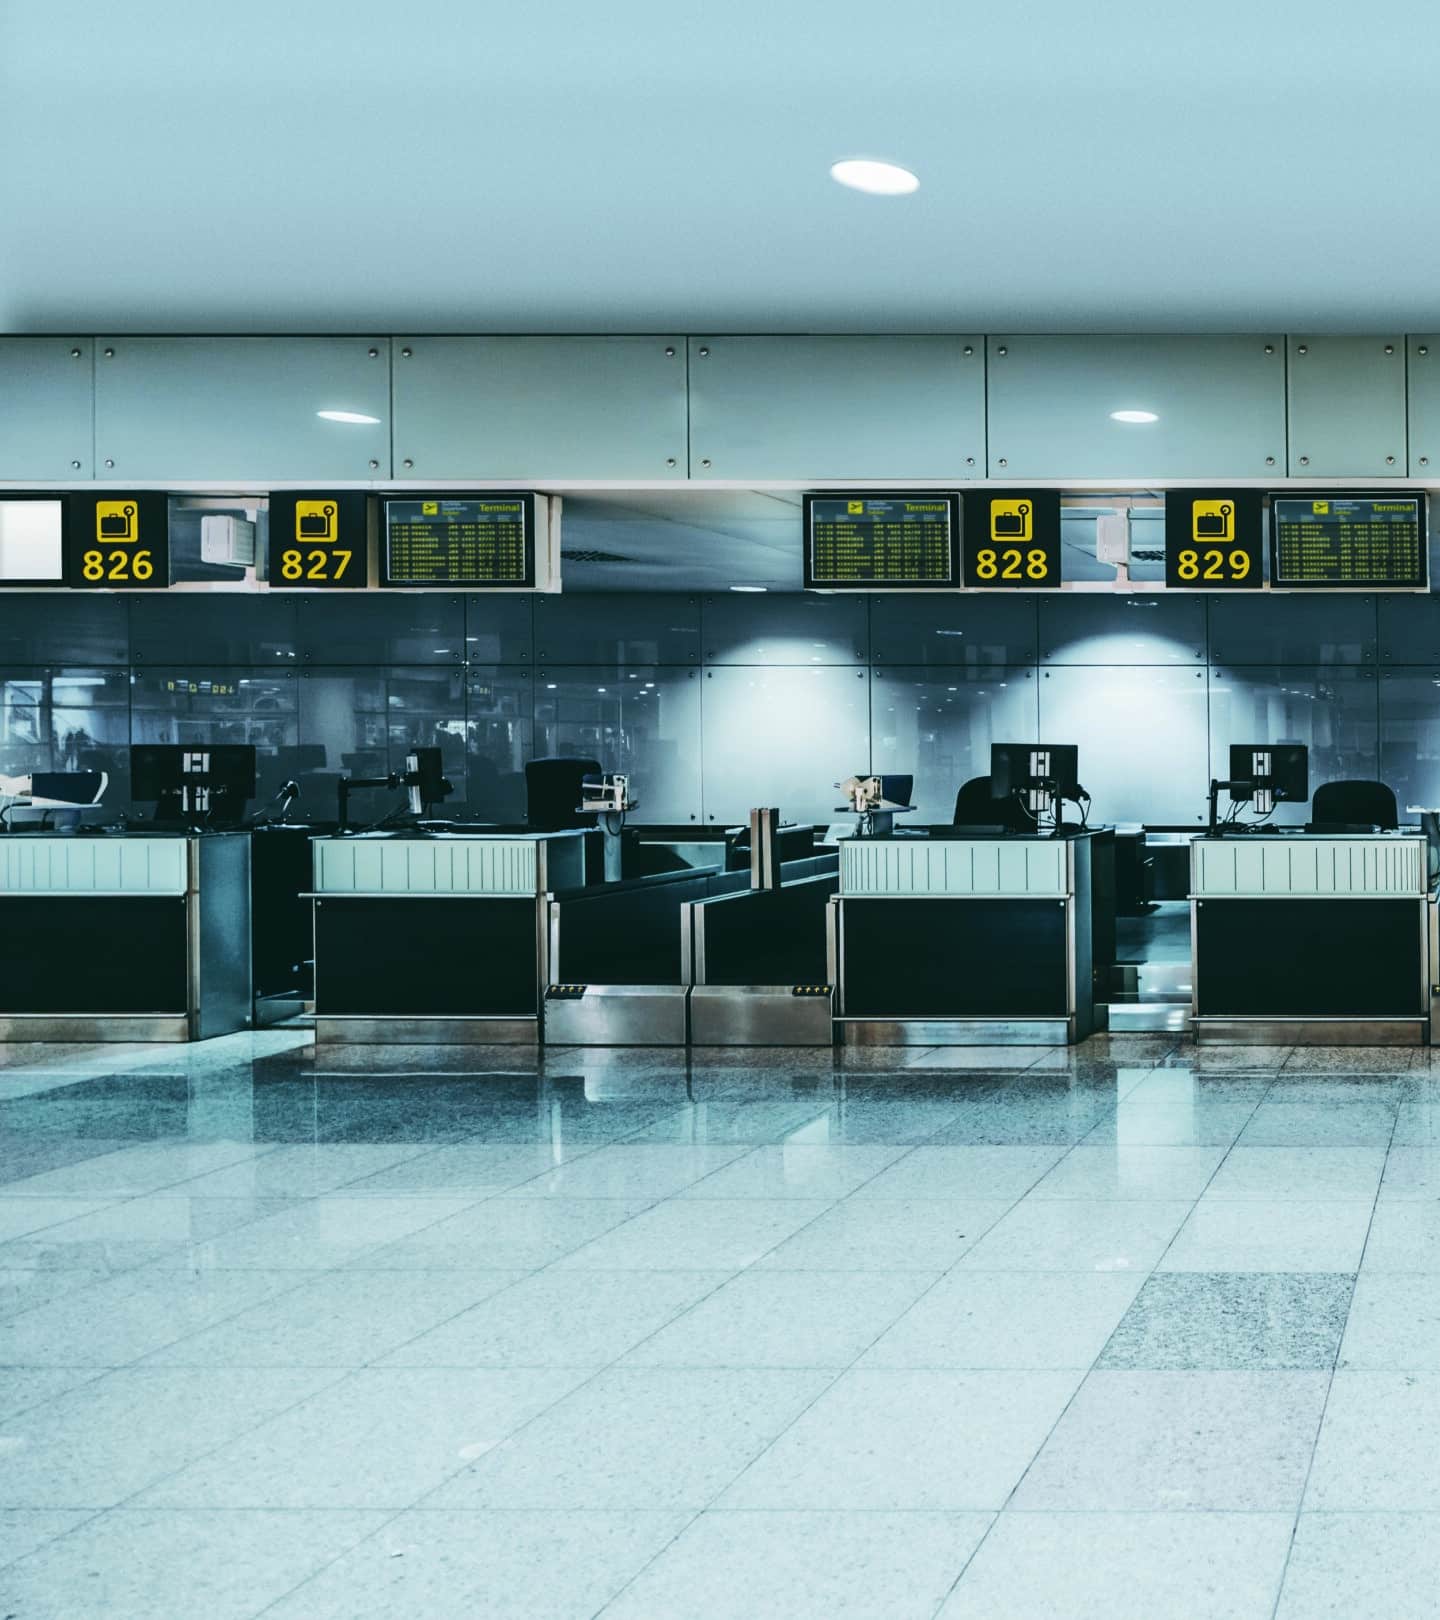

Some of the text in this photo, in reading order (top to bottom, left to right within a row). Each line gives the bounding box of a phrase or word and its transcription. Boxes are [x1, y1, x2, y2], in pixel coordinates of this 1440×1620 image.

[480, 504, 520, 512] Terminal
[905, 503, 945, 511] Terminal
[1372, 503, 1414, 511] Terminal
[82, 549, 154, 581] 826
[281, 549, 353, 580] 827
[975, 548, 1048, 580] 828
[1177, 549, 1251, 580] 829
